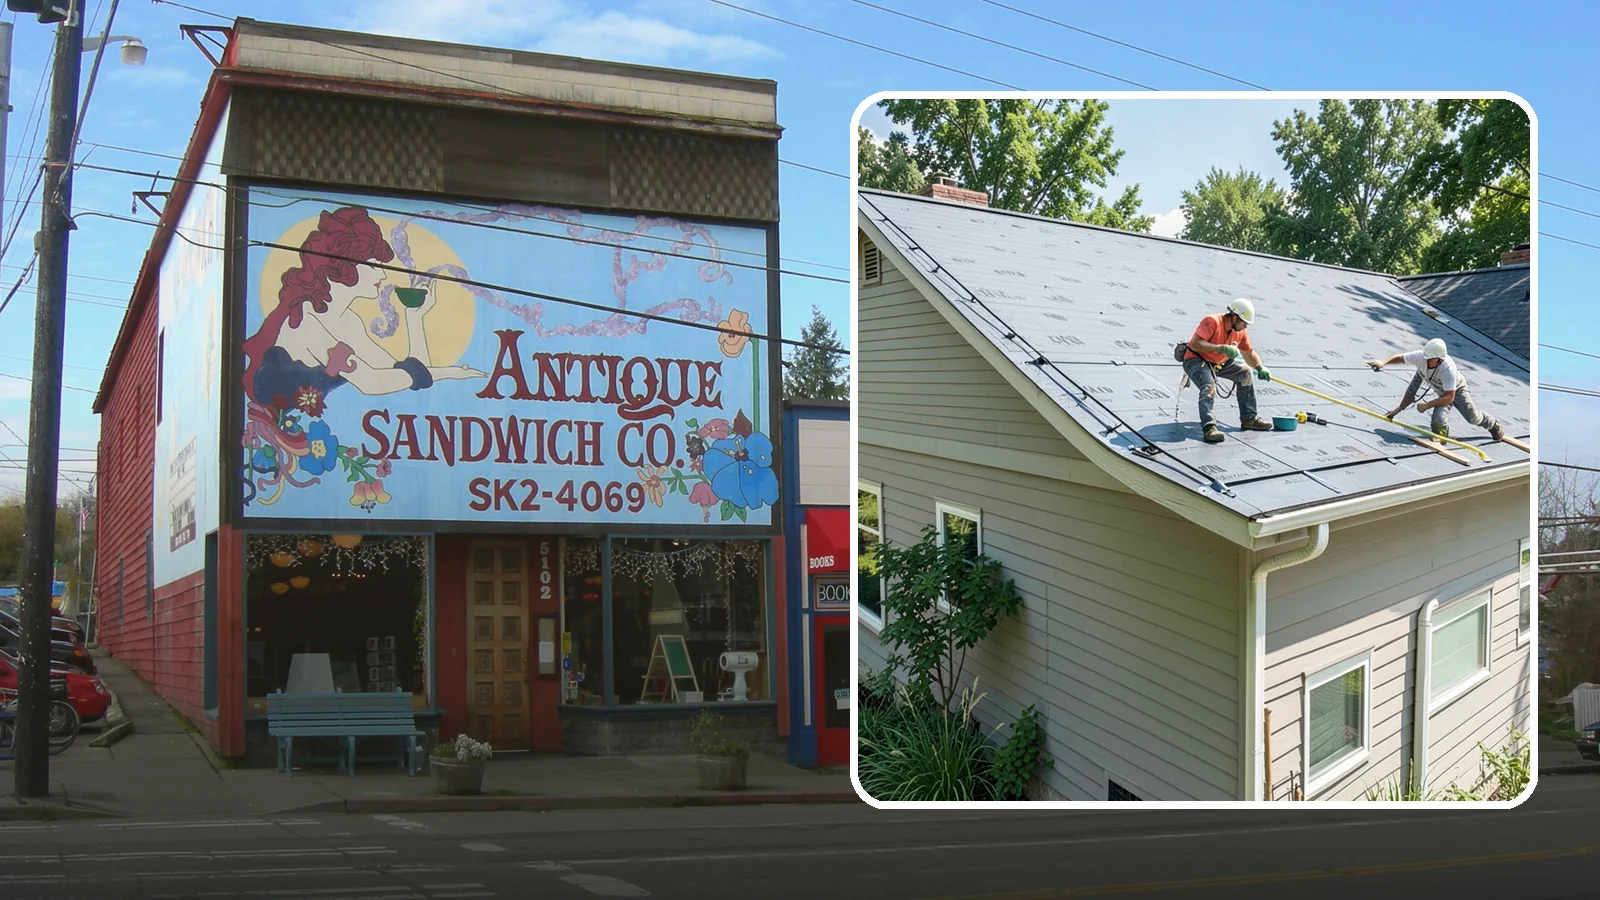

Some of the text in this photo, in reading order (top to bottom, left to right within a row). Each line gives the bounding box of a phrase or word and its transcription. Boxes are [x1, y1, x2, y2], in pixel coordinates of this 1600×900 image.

[475, 329, 723, 421] ANTIQUE
[361, 408, 685, 468] SANDWICH CO.
[468, 477, 645, 513] SK2-4069
[540, 541, 551, 599] 5102
[809, 555, 835, 569] BOOKS
